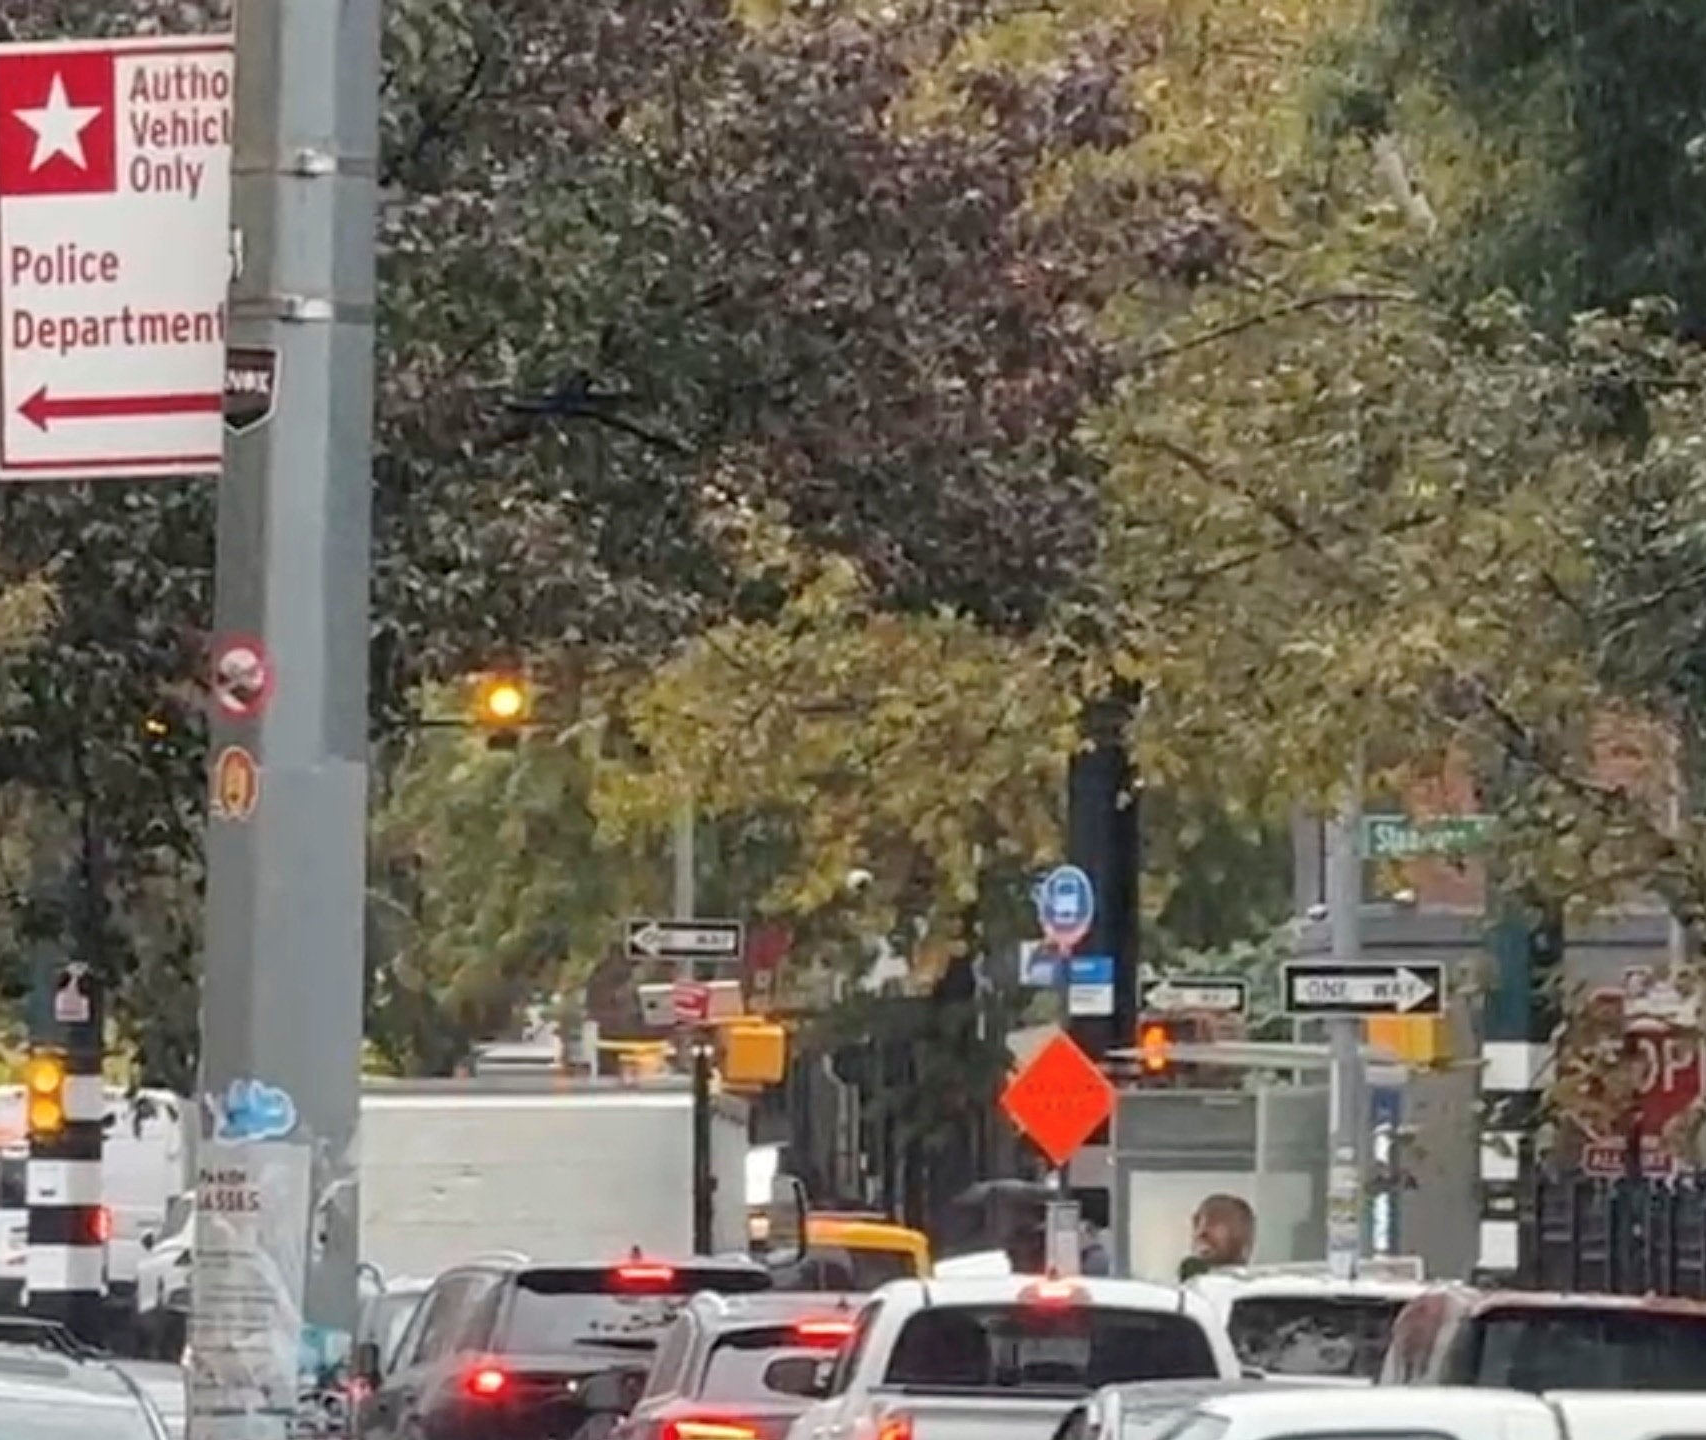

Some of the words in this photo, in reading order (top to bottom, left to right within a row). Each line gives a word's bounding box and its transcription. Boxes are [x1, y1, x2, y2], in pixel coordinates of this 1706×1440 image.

[129, 67, 228, 103] Autho
[130, 109, 231, 147] Vehicl
[130, 154, 204, 199] Only
[11, 242, 120, 285] Police
[12, 301, 225, 357] Department
[1305, 980, 1348, 999] ONE
[1372, 980, 1415, 999] WAY
